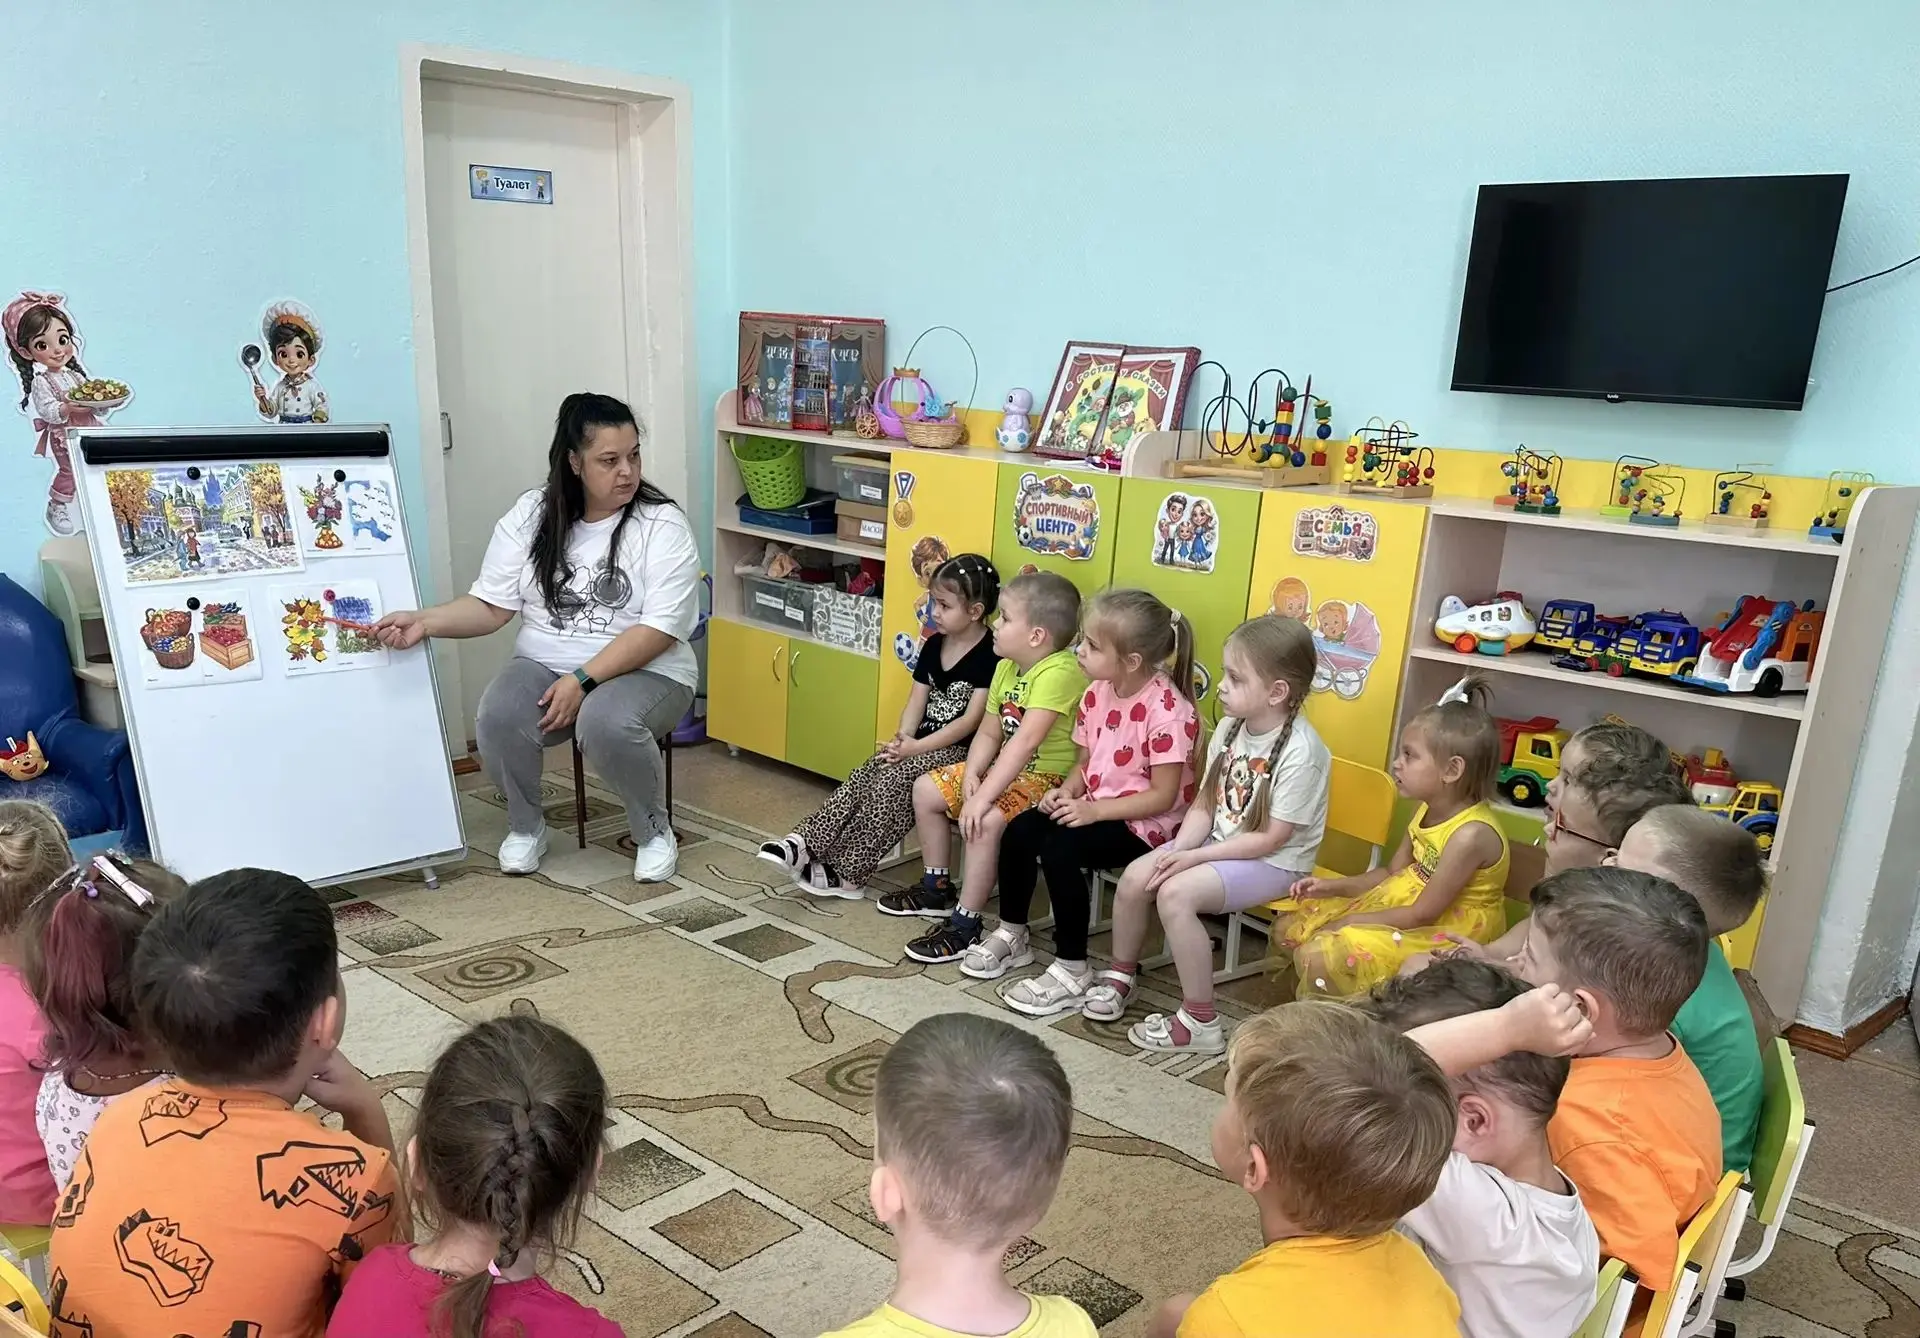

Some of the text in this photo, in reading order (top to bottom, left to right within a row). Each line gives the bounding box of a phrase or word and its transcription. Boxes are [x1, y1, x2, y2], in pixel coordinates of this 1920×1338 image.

[494, 177, 530, 191] Туалет
[1077, 363, 1115, 382] ГОСТЯХ
[1120, 369, 1129, 377] У
[1131, 370, 1167, 398] СКАЗКИ
[1026, 502, 1089, 523] СПОРТИВНЫЙ
[1036, 518, 1076, 535] ЦЕНТР
[1314, 519, 1362, 536] СЕМЬЯ
